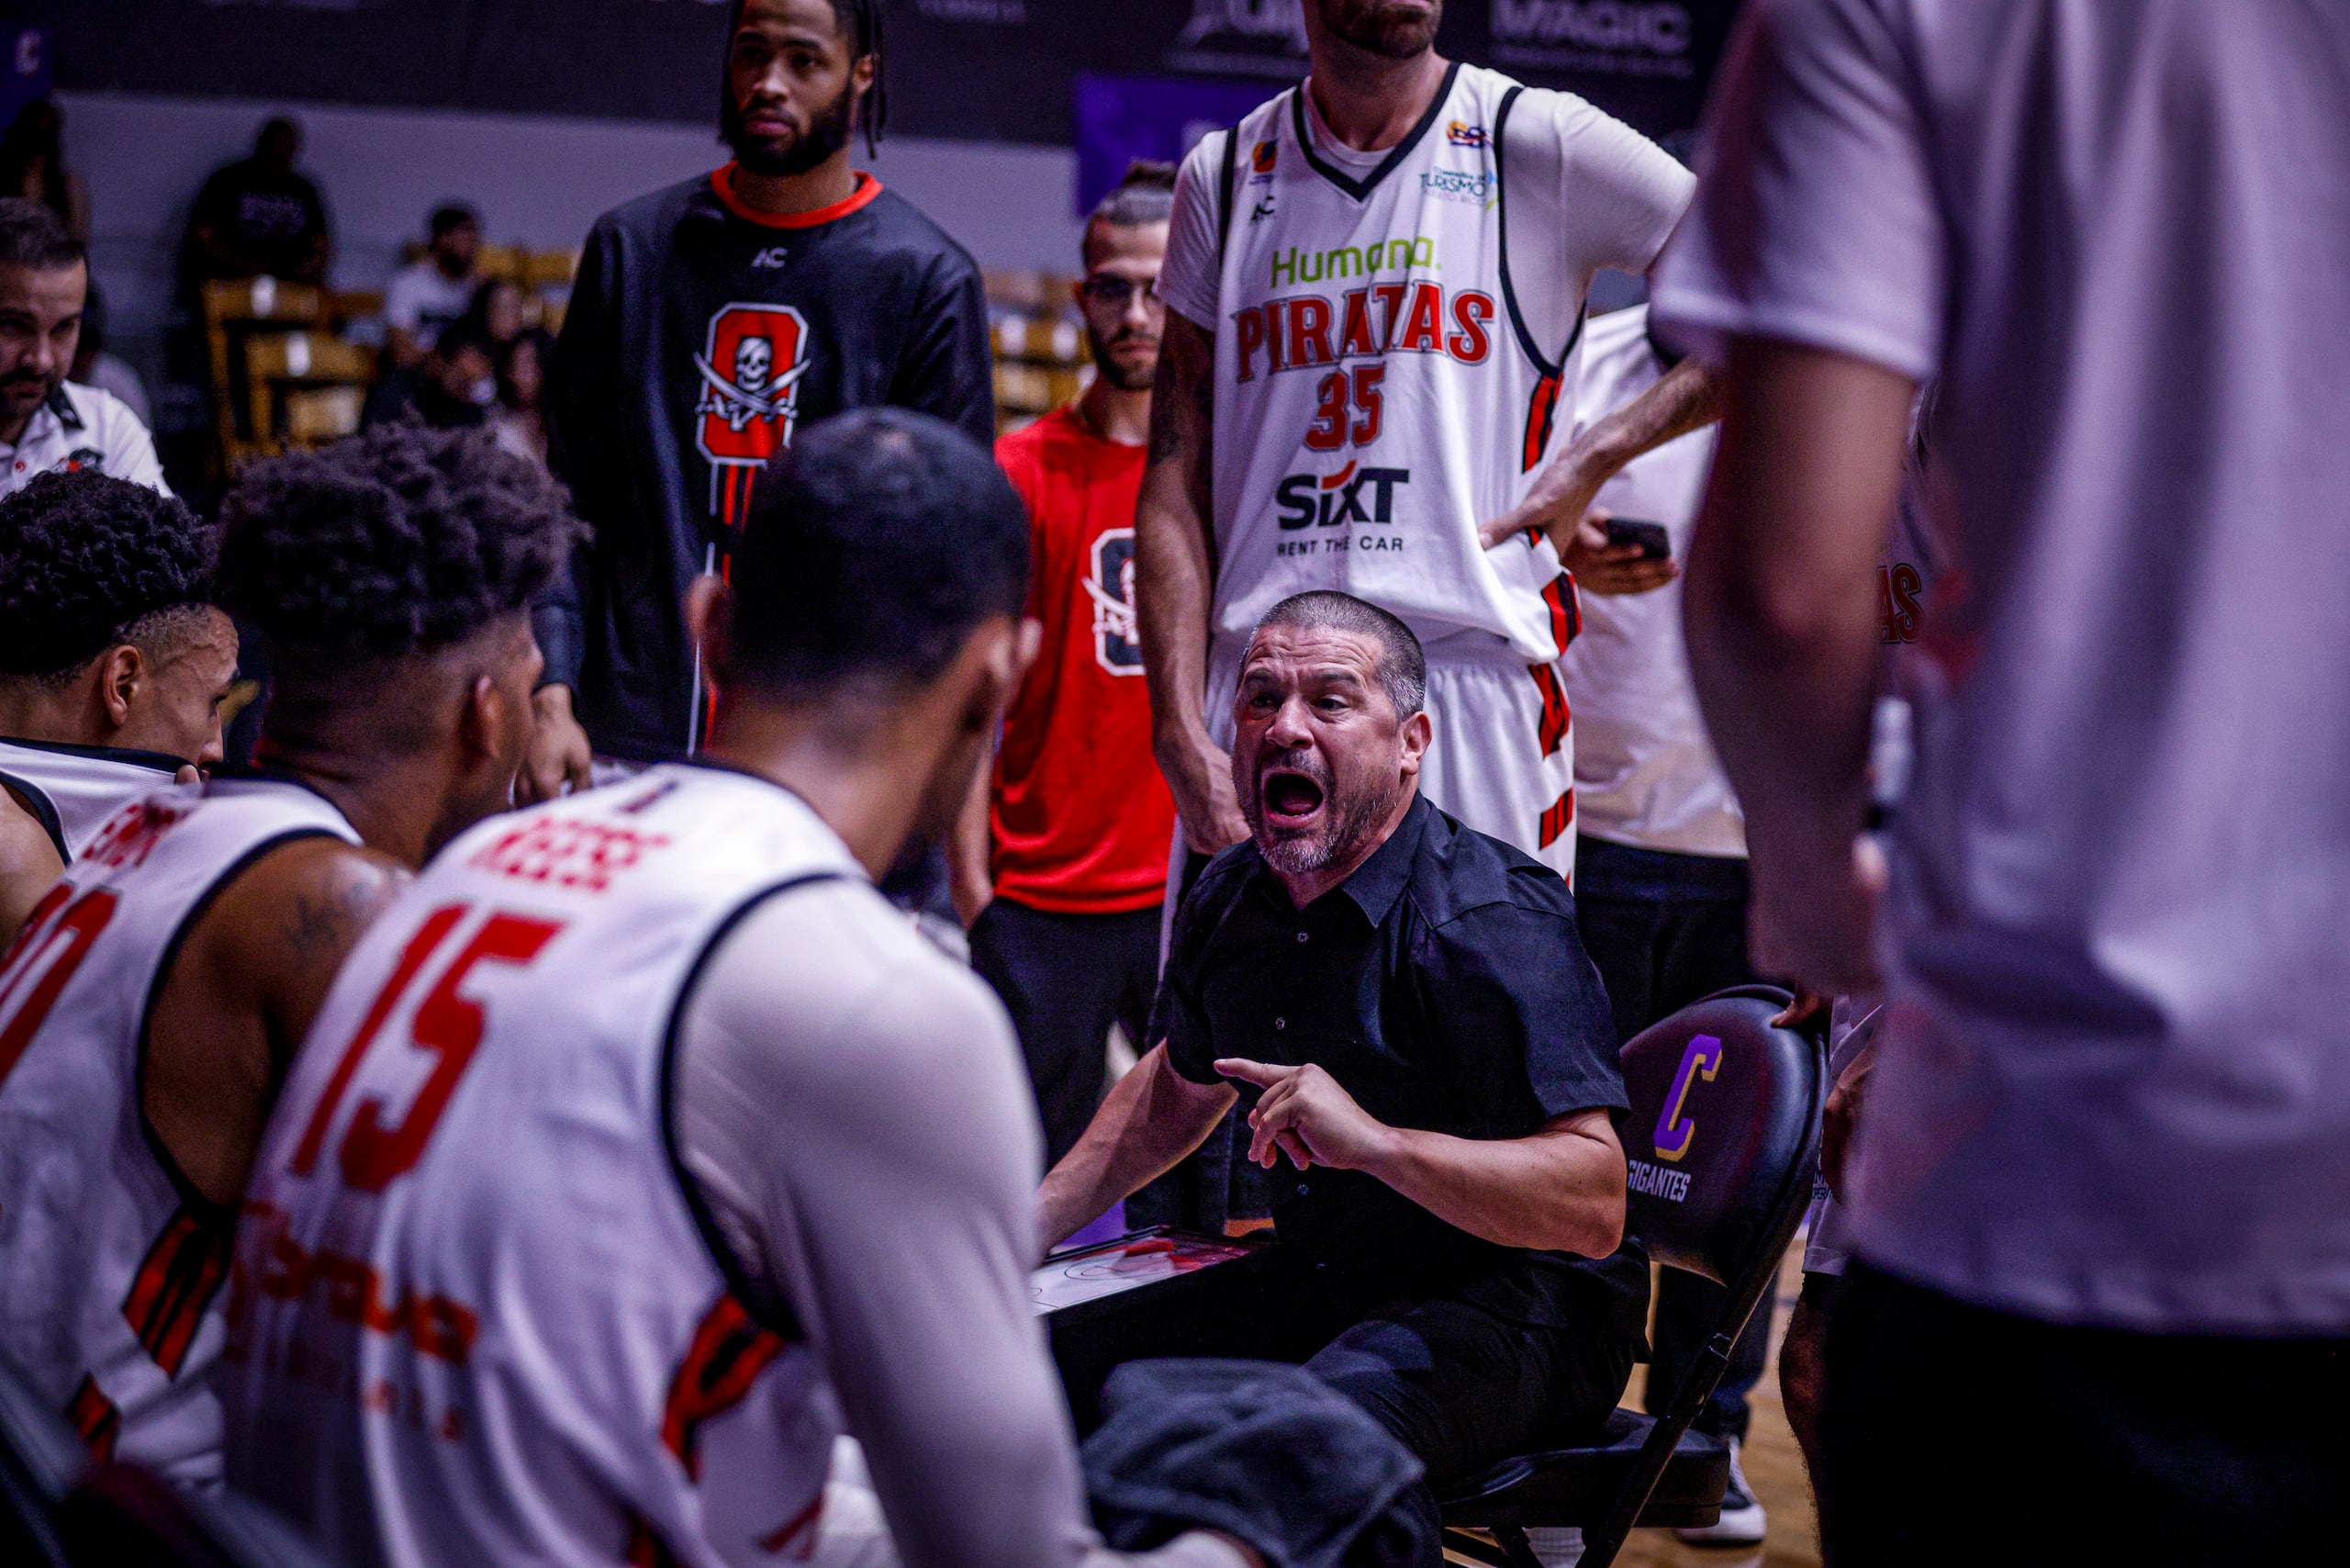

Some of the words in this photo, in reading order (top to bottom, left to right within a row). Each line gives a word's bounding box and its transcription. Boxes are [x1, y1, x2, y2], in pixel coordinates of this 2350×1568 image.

[751, 248, 788, 268] AC
[1231, 279, 1496, 384] PIRATAS
[1304, 361, 1387, 452] 35
[1277, 539, 1318, 556] RENT
[1326, 535, 1350, 552] THE
[1360, 535, 1404, 551] CAR
[287, 900, 567, 1194] 15
[1653, 1034, 1722, 1161] C
[1628, 1159, 1691, 1203] GIGANTES
